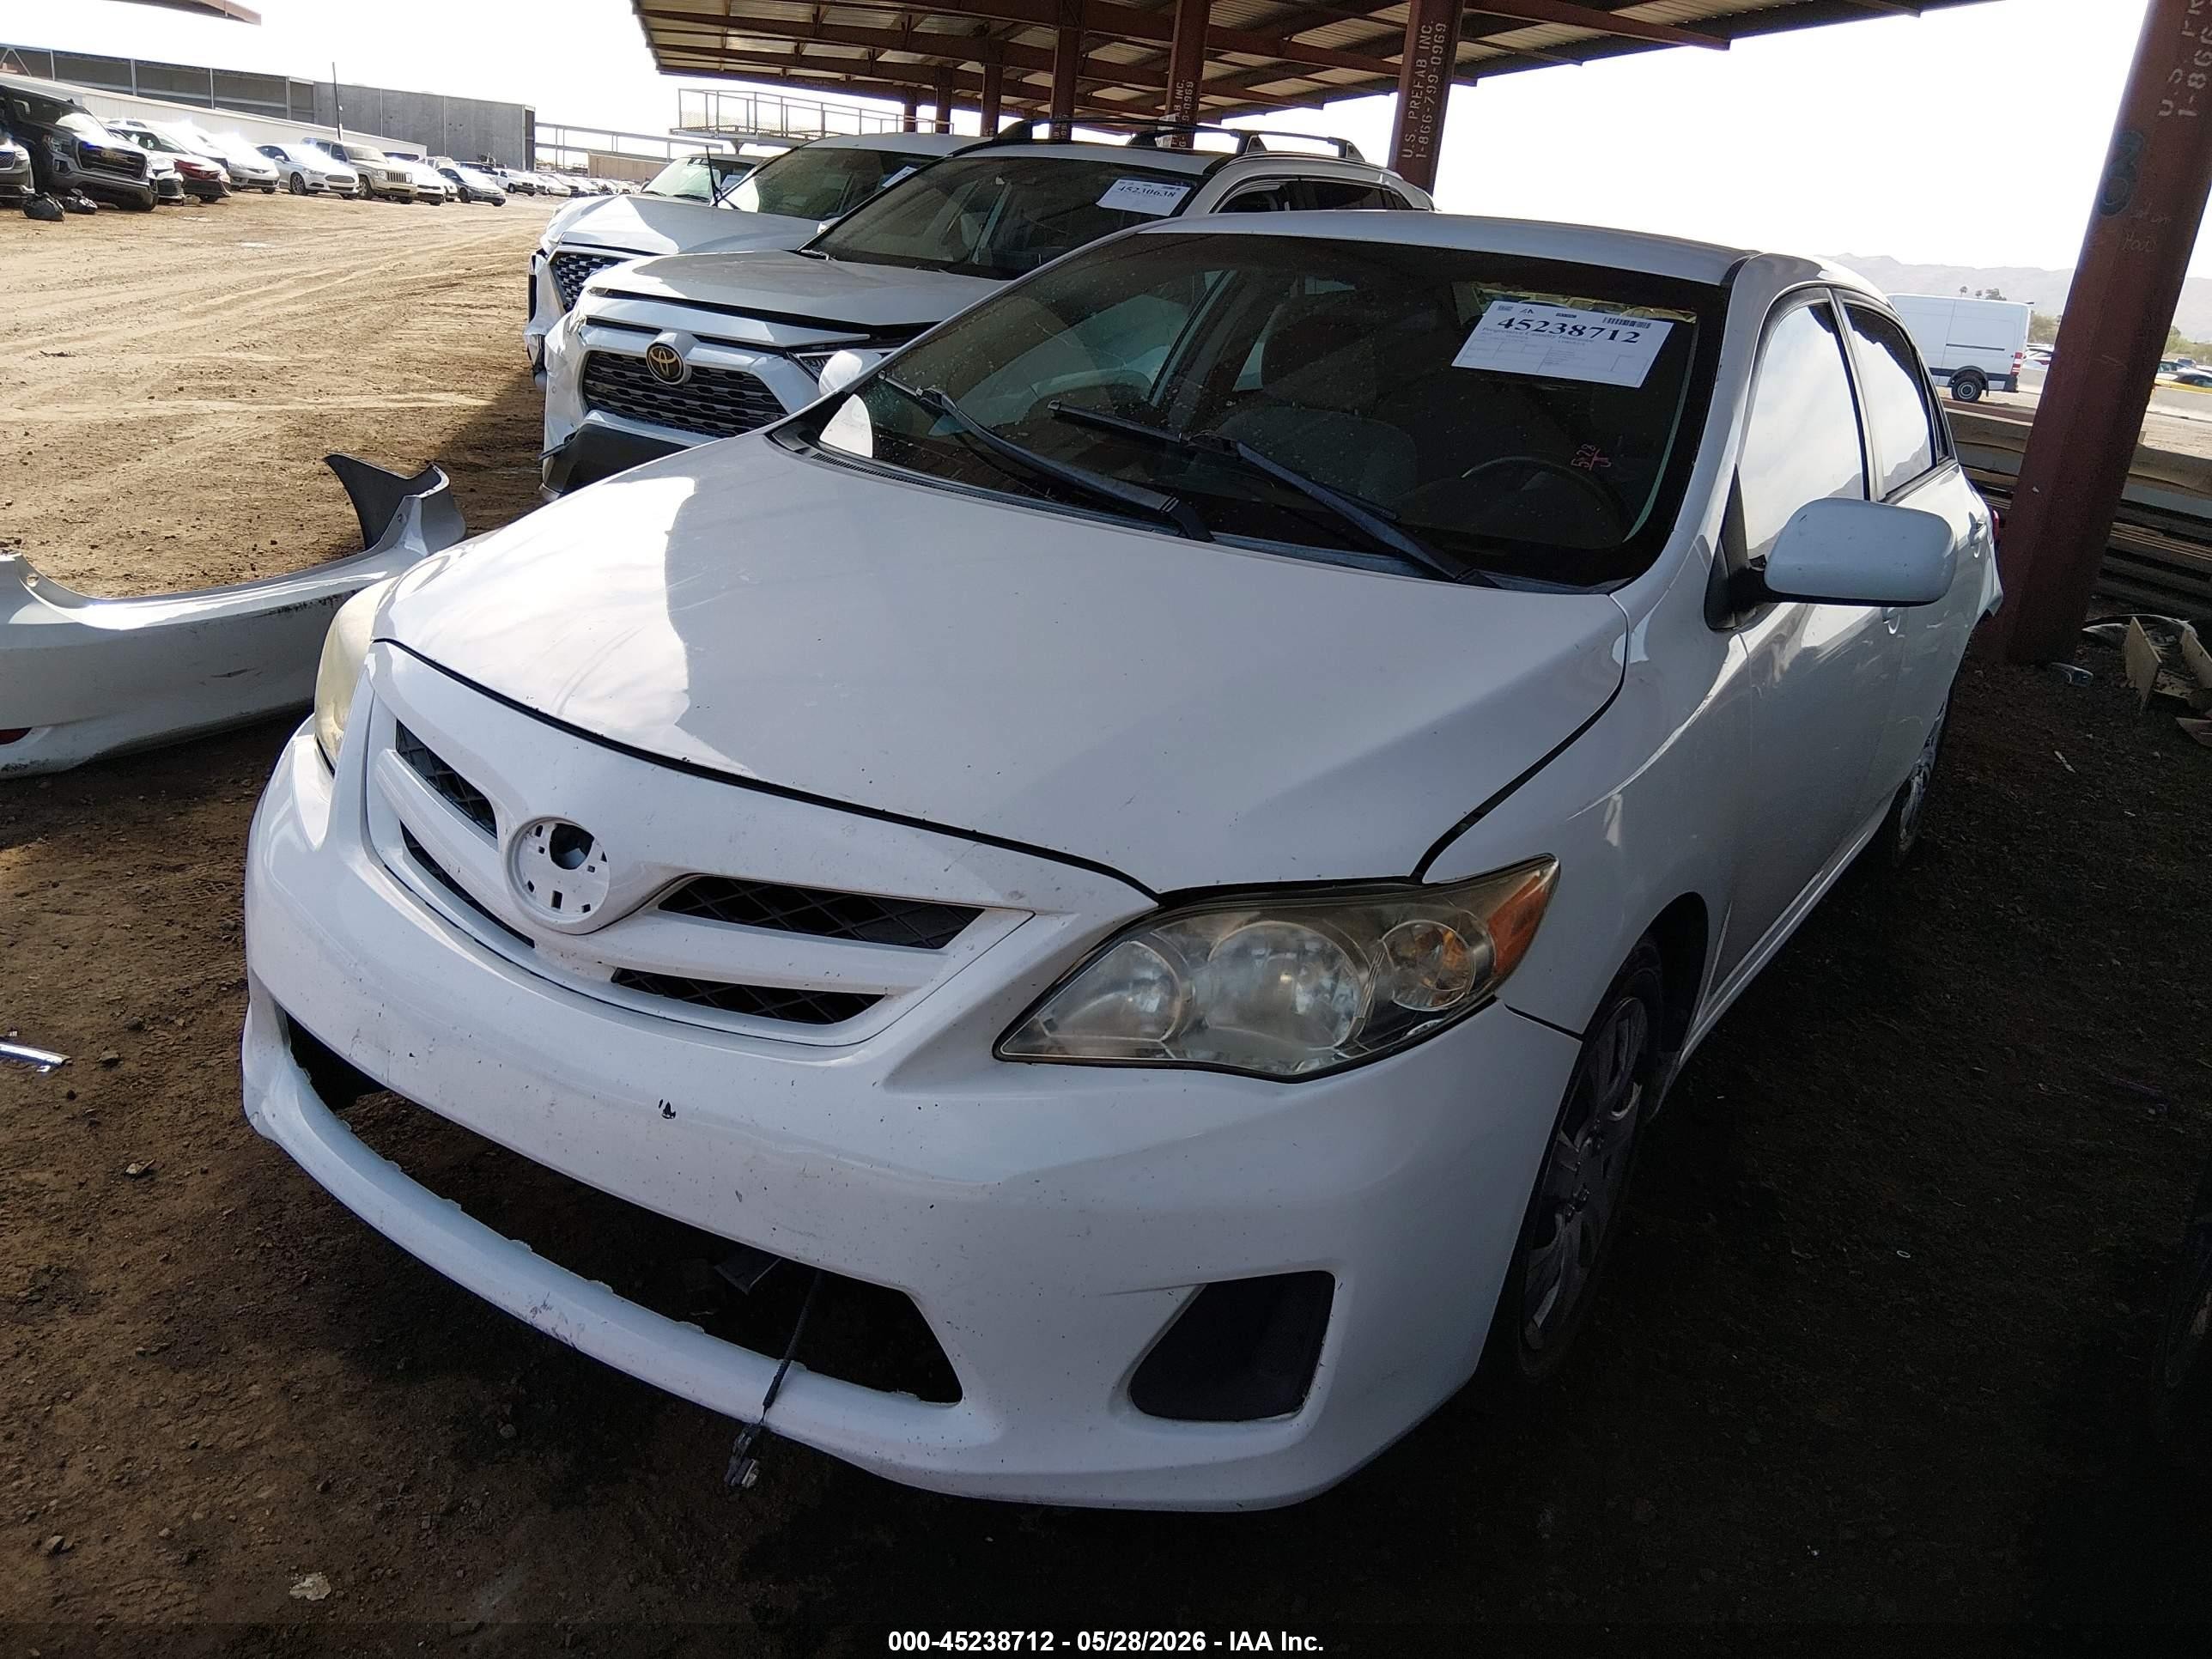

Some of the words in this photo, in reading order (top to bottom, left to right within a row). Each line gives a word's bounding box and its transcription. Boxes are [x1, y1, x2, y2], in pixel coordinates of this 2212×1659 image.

[1419, 20, 1434, 50] INC.
[1408, 58, 1427, 119] PREFAB
[1416, 22, 1447, 158] 1-866-799-0969
[1401, 129, 1417, 158] U.S.
[1497, 317, 1641, 343] 45238712
